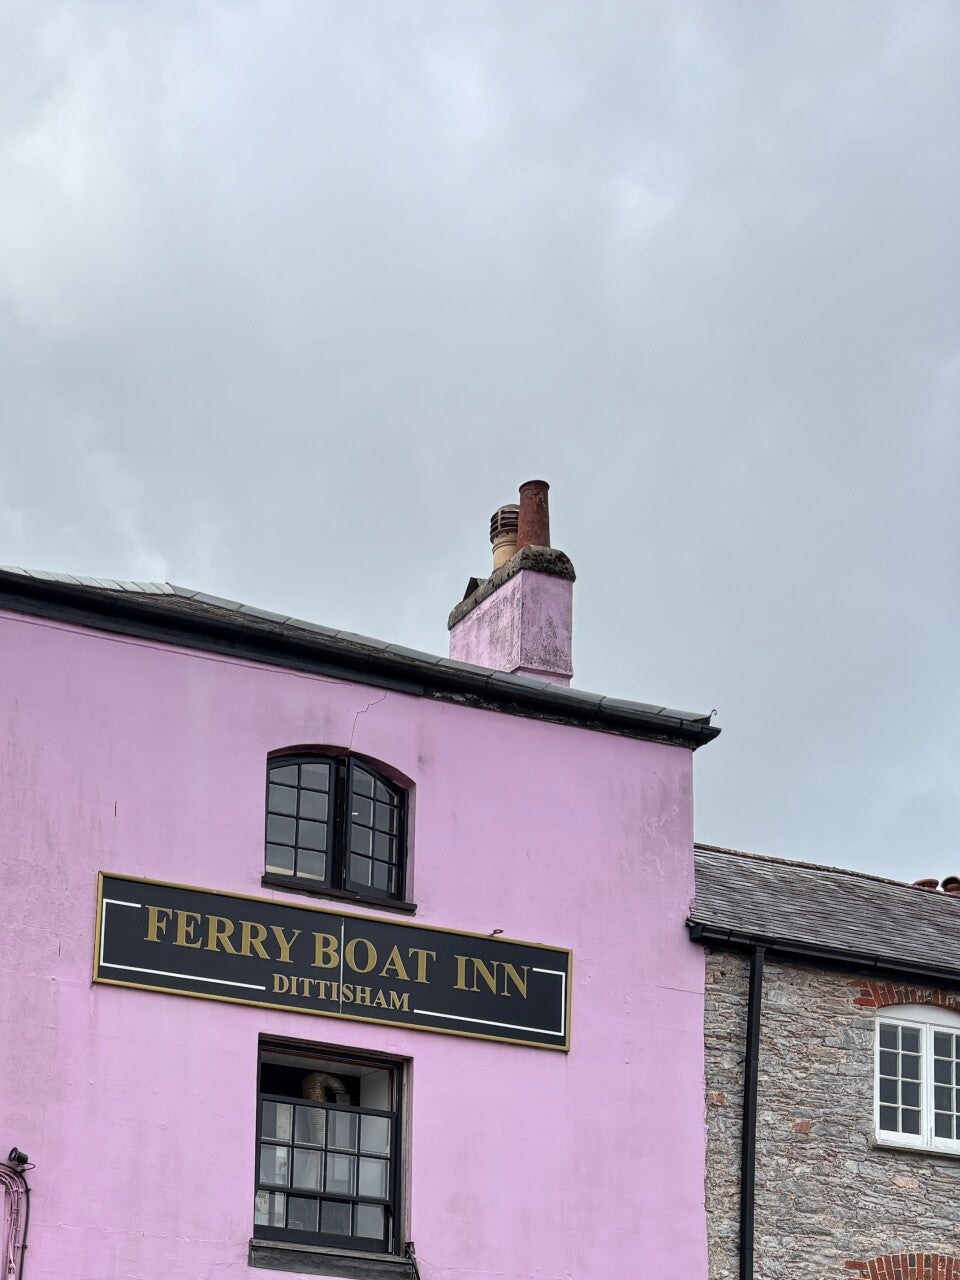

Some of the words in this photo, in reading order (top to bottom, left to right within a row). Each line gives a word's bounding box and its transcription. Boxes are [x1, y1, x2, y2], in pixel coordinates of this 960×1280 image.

[143, 904, 303, 964] FERRY
[310, 931, 437, 984] BOAT
[453, 954, 531, 1000] INN
[271, 973, 411, 1012] DITTISHAM
